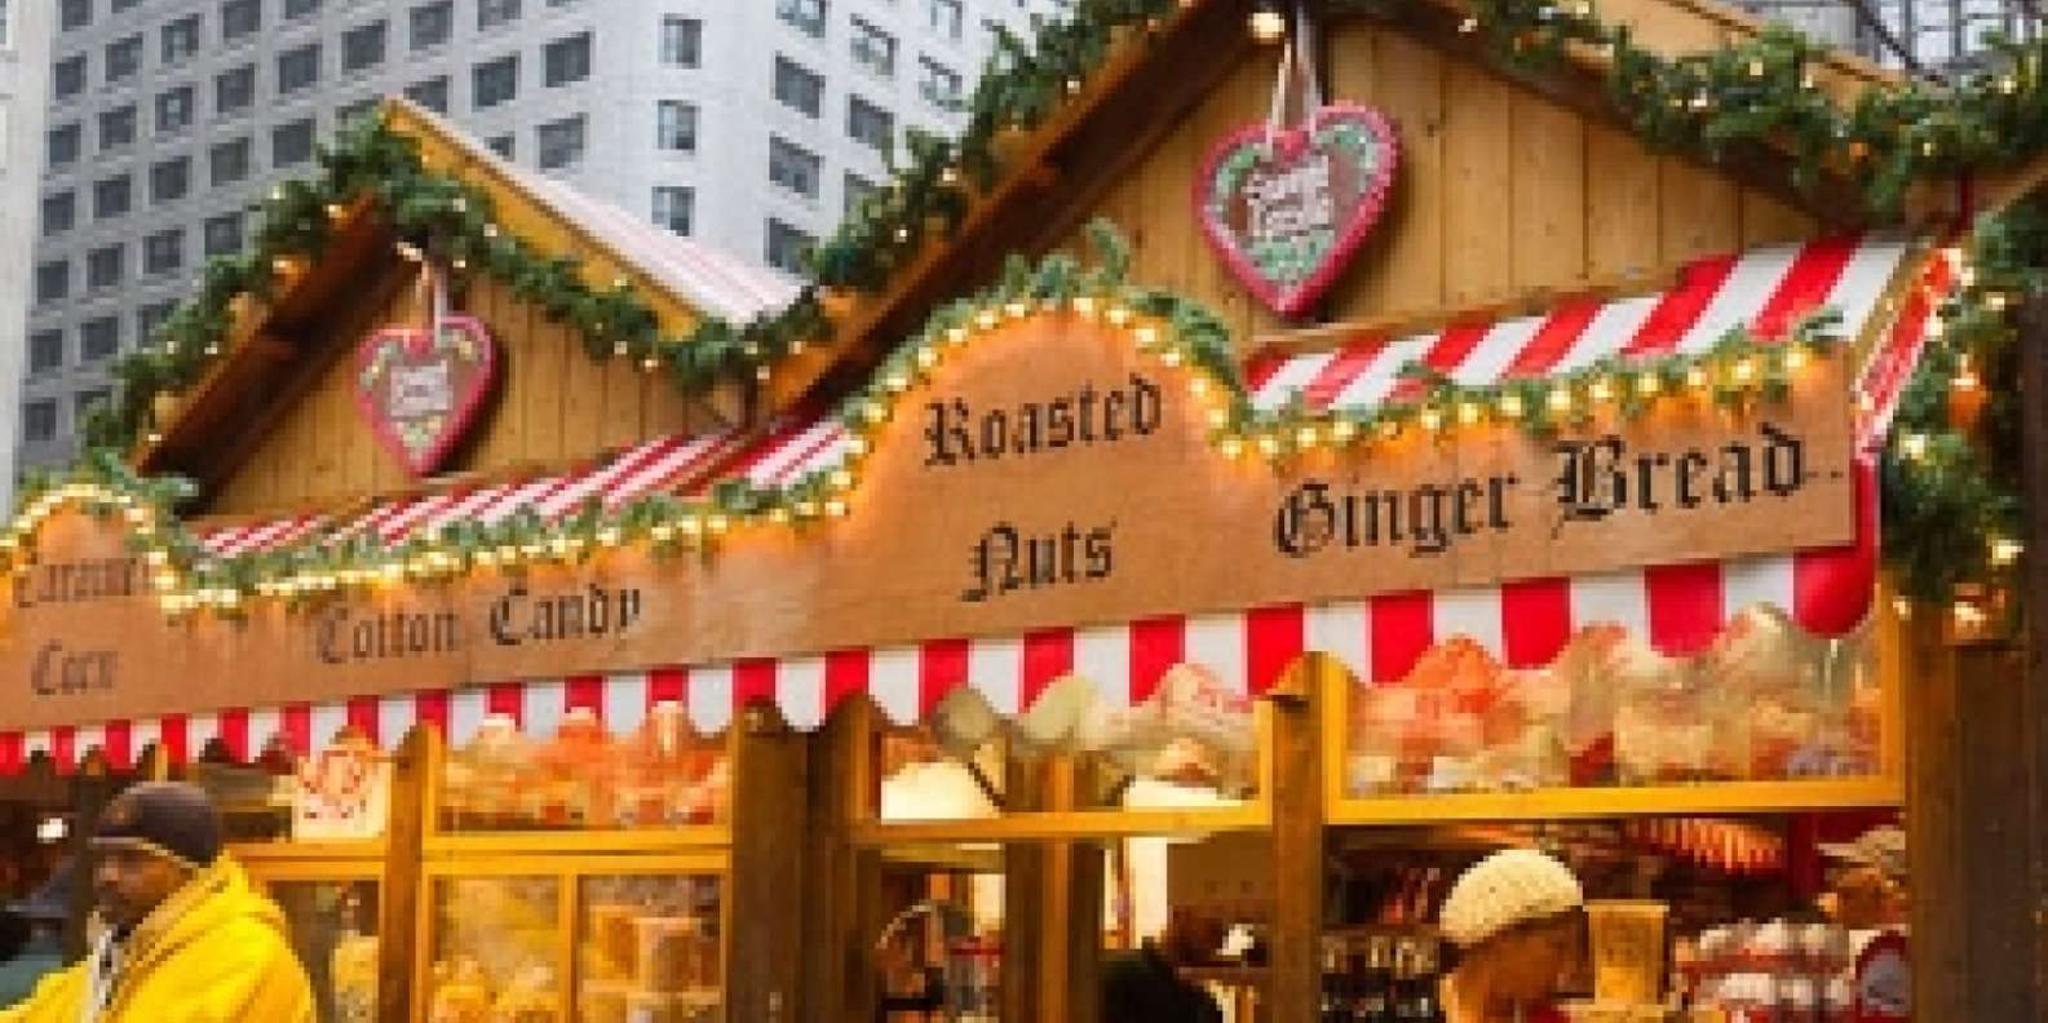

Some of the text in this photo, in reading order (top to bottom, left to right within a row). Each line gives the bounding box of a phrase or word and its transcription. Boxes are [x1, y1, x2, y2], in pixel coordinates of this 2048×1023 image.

[925, 372, 1161, 466] Roasted
[960, 518, 1117, 603] Nuts
[1273, 477, 1519, 557] Ginger
[317, 571, 641, 664] Cotton Candy
